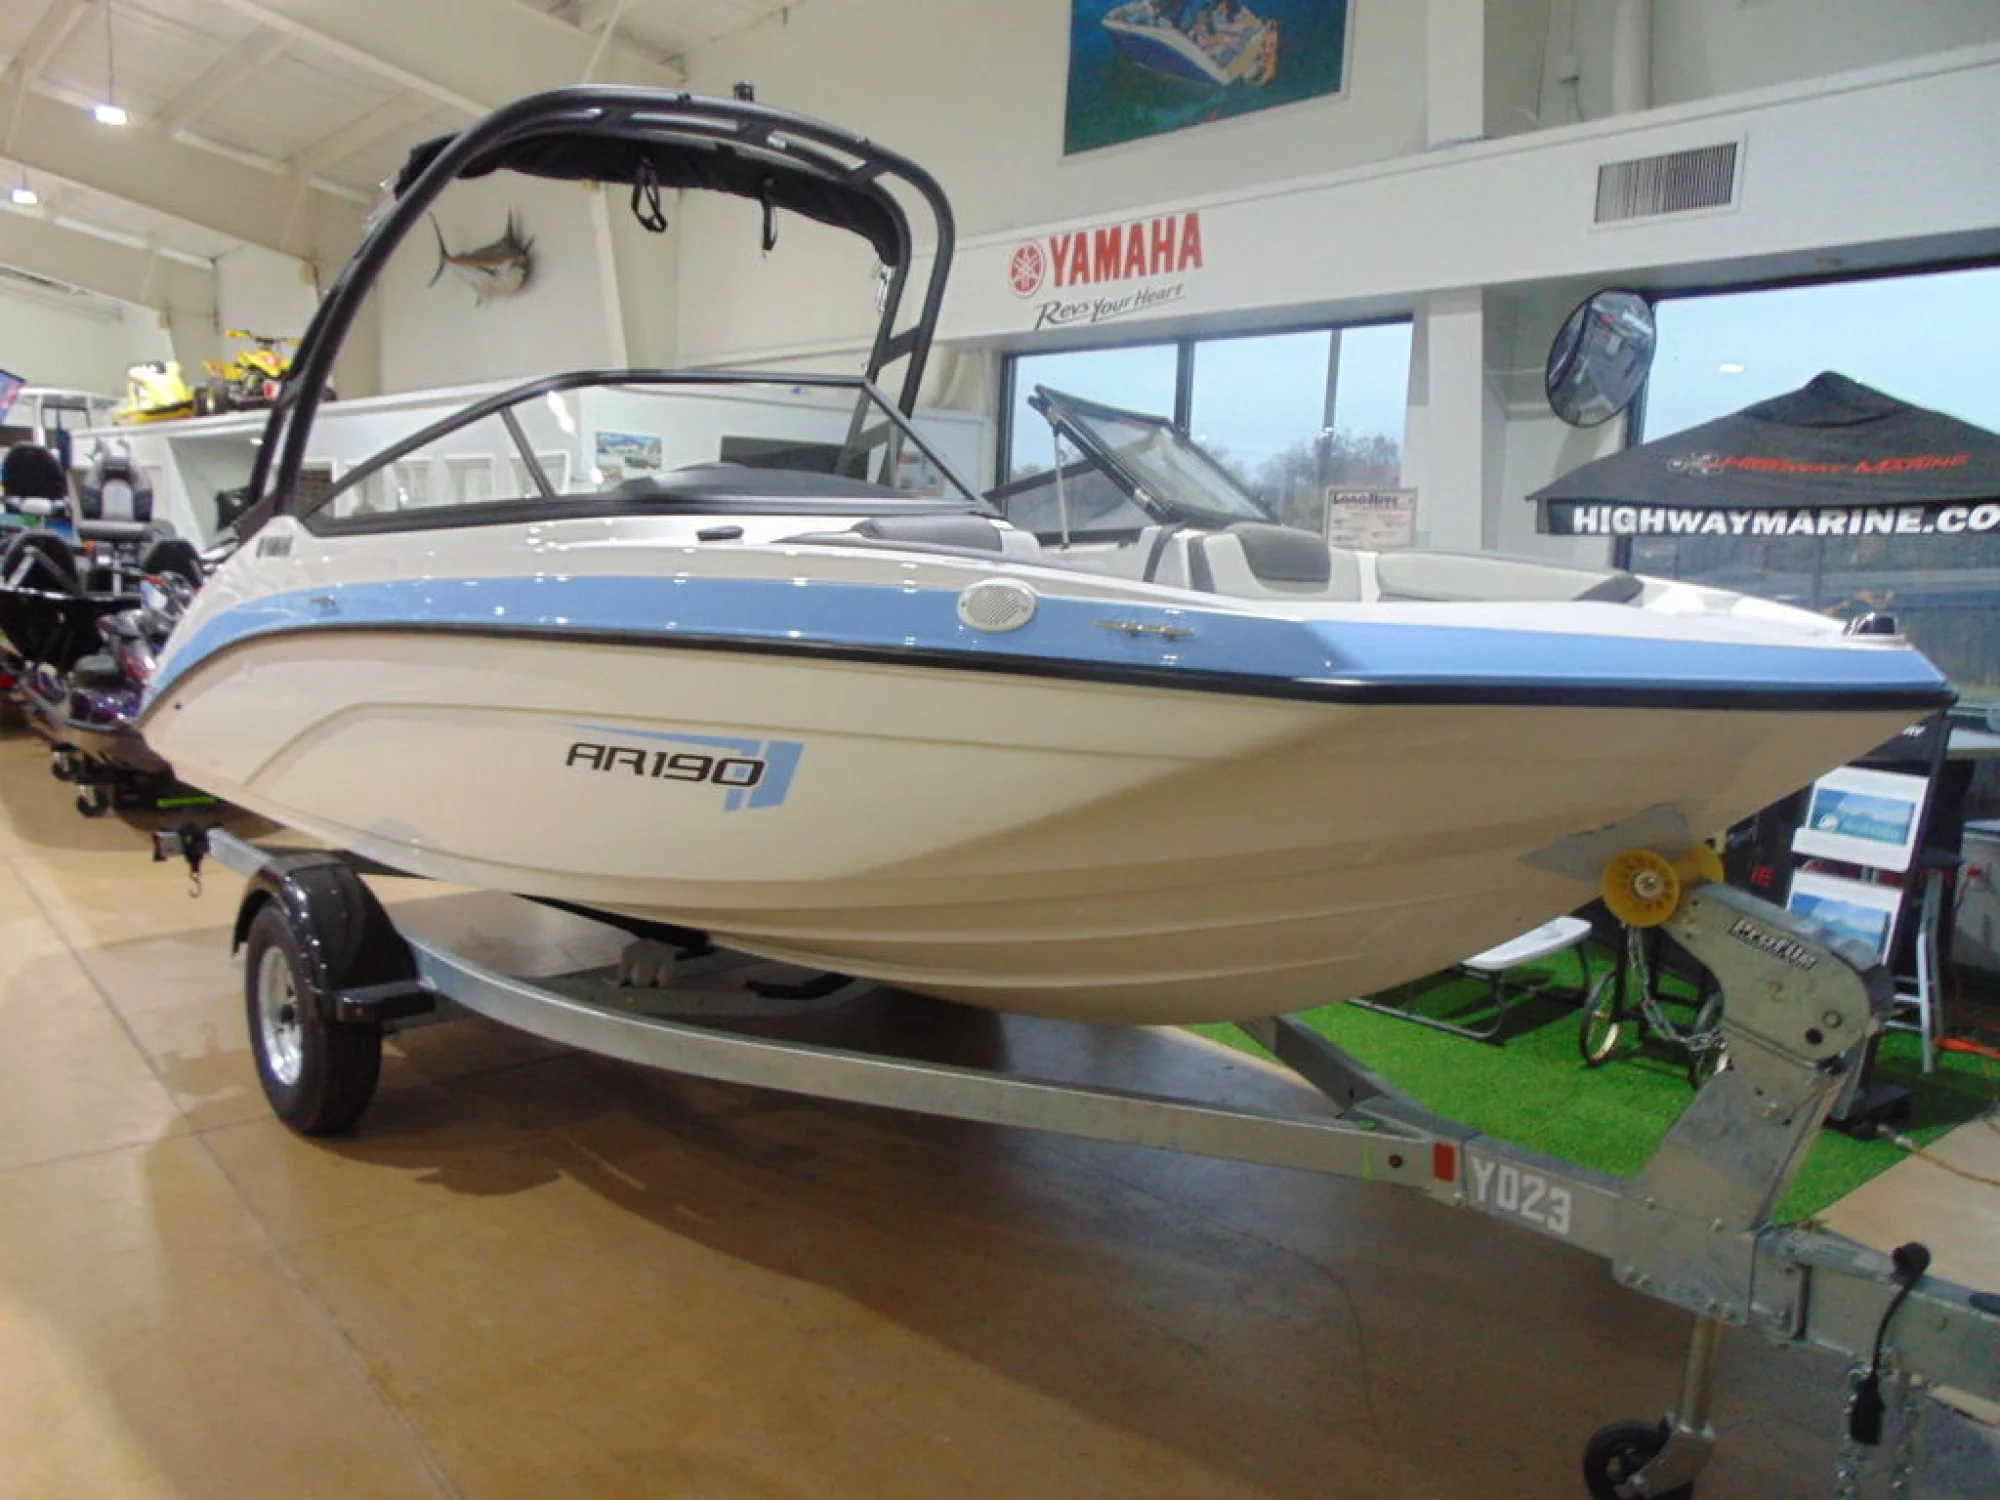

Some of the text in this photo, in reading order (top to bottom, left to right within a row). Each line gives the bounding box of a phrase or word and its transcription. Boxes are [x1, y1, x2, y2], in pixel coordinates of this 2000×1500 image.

[1049, 212, 1203, 288] YAMAHA
[1033, 282, 1184, 331] Revs Your Heart
[565, 742, 766, 787] AR190
[1471, 1155, 1571, 1235] Y023
